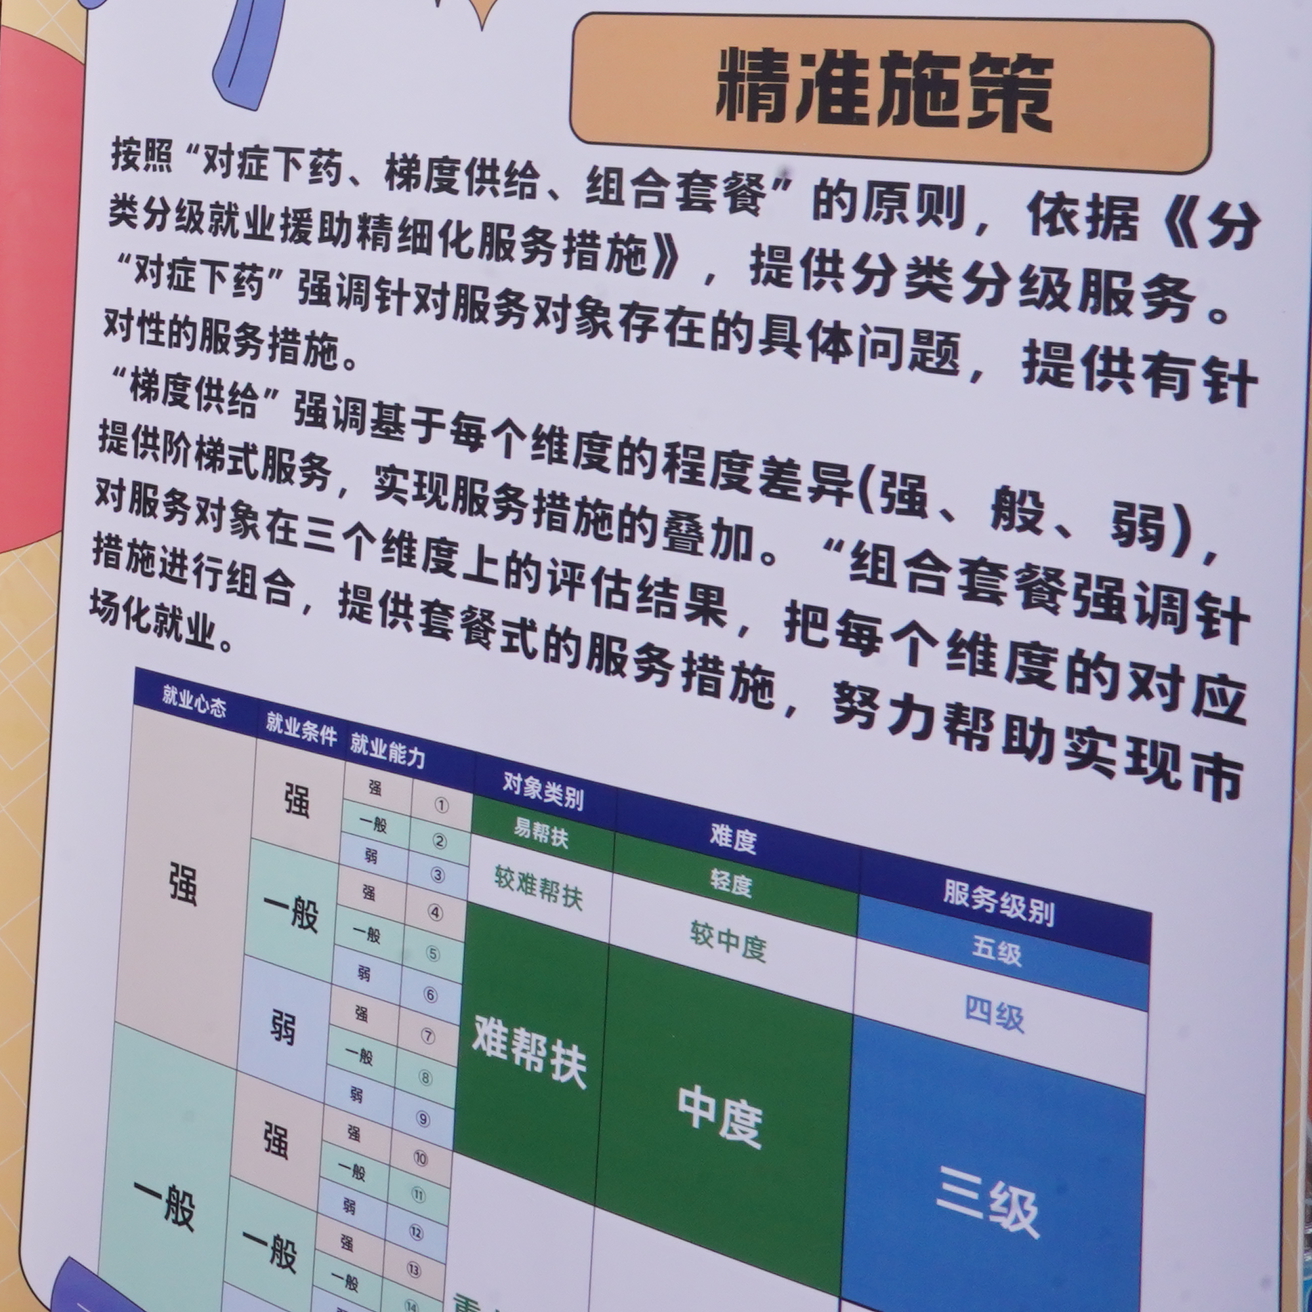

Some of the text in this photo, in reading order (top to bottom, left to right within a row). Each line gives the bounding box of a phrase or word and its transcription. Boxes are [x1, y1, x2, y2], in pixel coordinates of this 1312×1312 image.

[717, 46, 1056, 135] 精准施策
[104, 307, 357, 372] 对性的服务措施。
[89, 587, 234, 653] 场化就业。
[162, 684, 227, 720] 就业心态
[266, 711, 338, 748] 就业条件
[350, 732, 426, 771] 就业能力
[284, 783, 311, 819] 强
[369, 779, 382, 797] 强
[503, 771, 585, 813] 对象类别
[359, 816, 388, 834] 一般
[514, 816, 570, 850] 易帮扶
[710, 824, 758, 856] 难度
[365, 848, 378, 865] 弱
[169, 861, 198, 907] 强
[362, 884, 376, 902] 强
[494, 864, 585, 912] 较难帮扶
[710, 868, 753, 898] 轻度
[263, 895, 319, 934] 一般
[943, 879, 1055, 928] 服务级别
[353, 927, 381, 944] 一般
[690, 920, 768, 965] 较中度
[973, 936, 1023, 968] 五级
[358, 965, 371, 983] 弱
[270, 1009, 297, 1047] 弱
[355, 1005, 369, 1023] 强
[965, 994, 1025, 1035] 四级
[346, 1046, 374, 1066] 一般
[472, 1014, 588, 1090] 难帮扶
[350, 1086, 363, 1104] 弱
[348, 1124, 361, 1142] 强
[678, 1084, 763, 1150] 中度
[263, 1121, 290, 1161] 强
[338, 1161, 367, 1182] 一般
[134, 1180, 196, 1233] 一般
[343, 1196, 356, 1215] 弱
[936, 1165, 1040, 1241] 三级
[242, 1230, 298, 1275] 一般
[340, 1233, 354, 1253] 强
[330, 1272, 359, 1293] 一般
